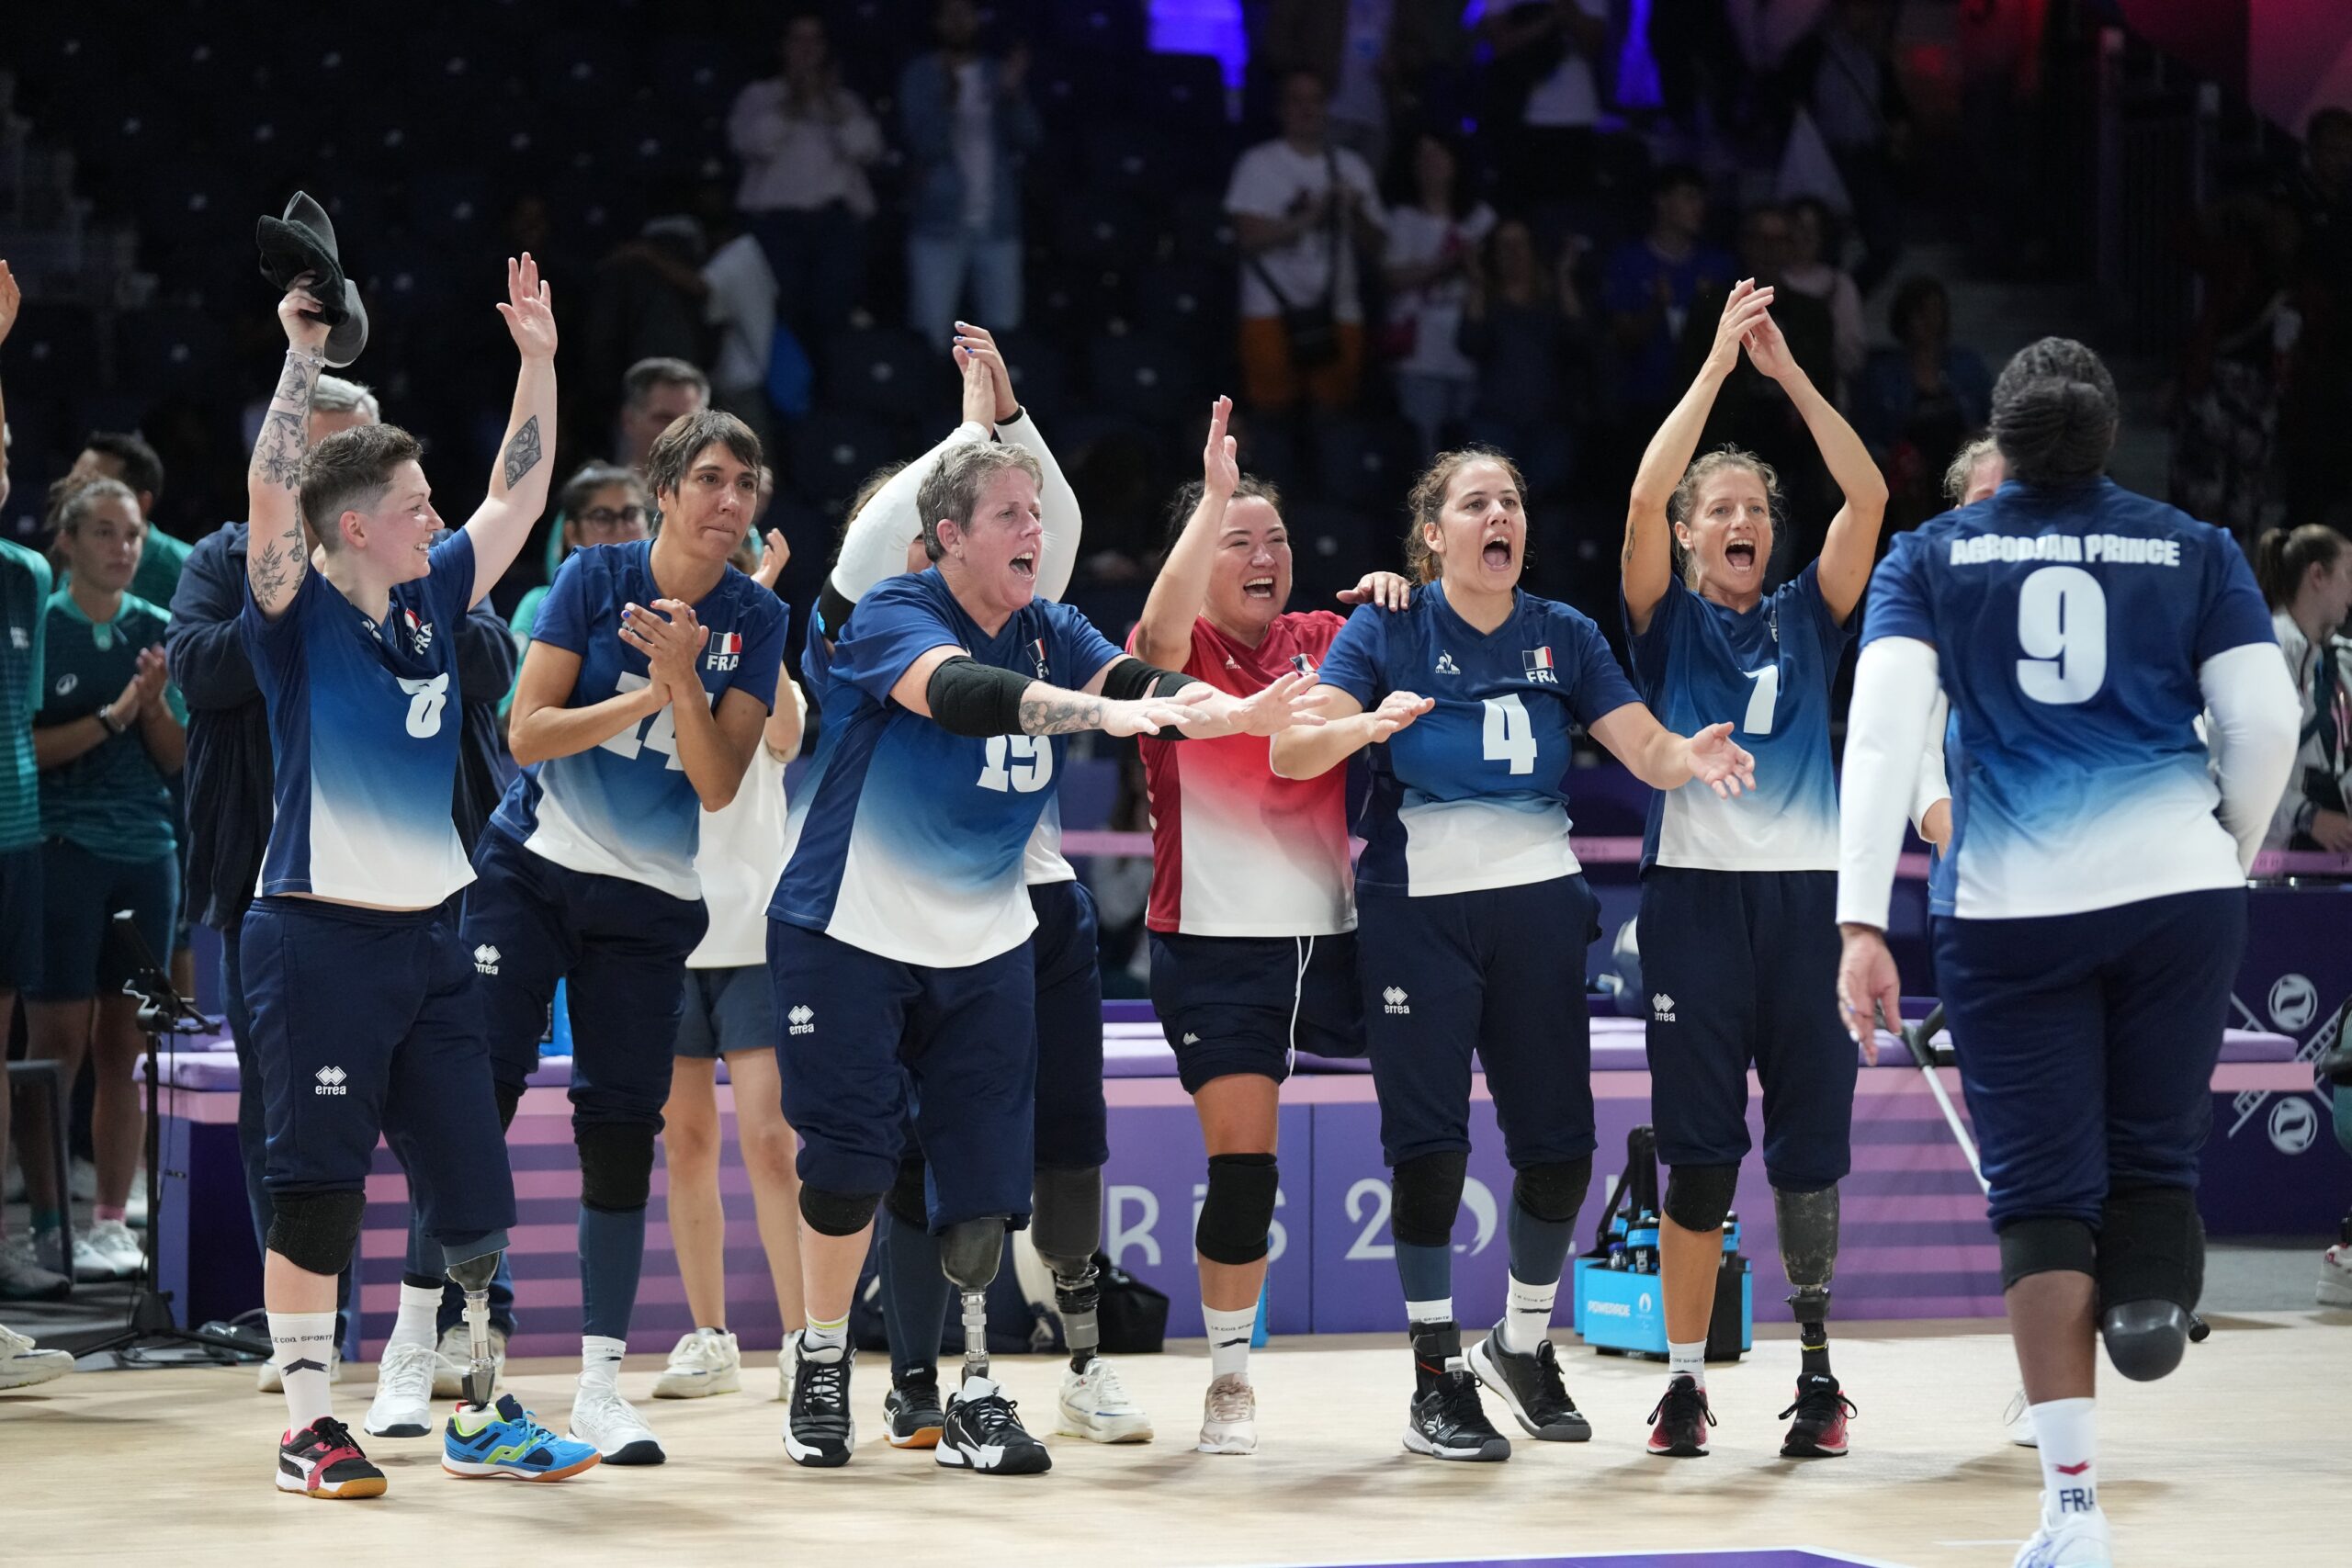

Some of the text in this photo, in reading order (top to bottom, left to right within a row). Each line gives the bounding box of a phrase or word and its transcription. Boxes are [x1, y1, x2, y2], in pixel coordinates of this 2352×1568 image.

[2084, 534, 2181, 567] PRINCE
[414, 622, 433, 655] FRA
[2017, 566, 2108, 705] 9
[707, 654, 740, 671] FRA
[1525, 669, 1559, 683] FRA
[1481, 693, 1538, 774] 4
[314, 1085, 347, 1096] errea
